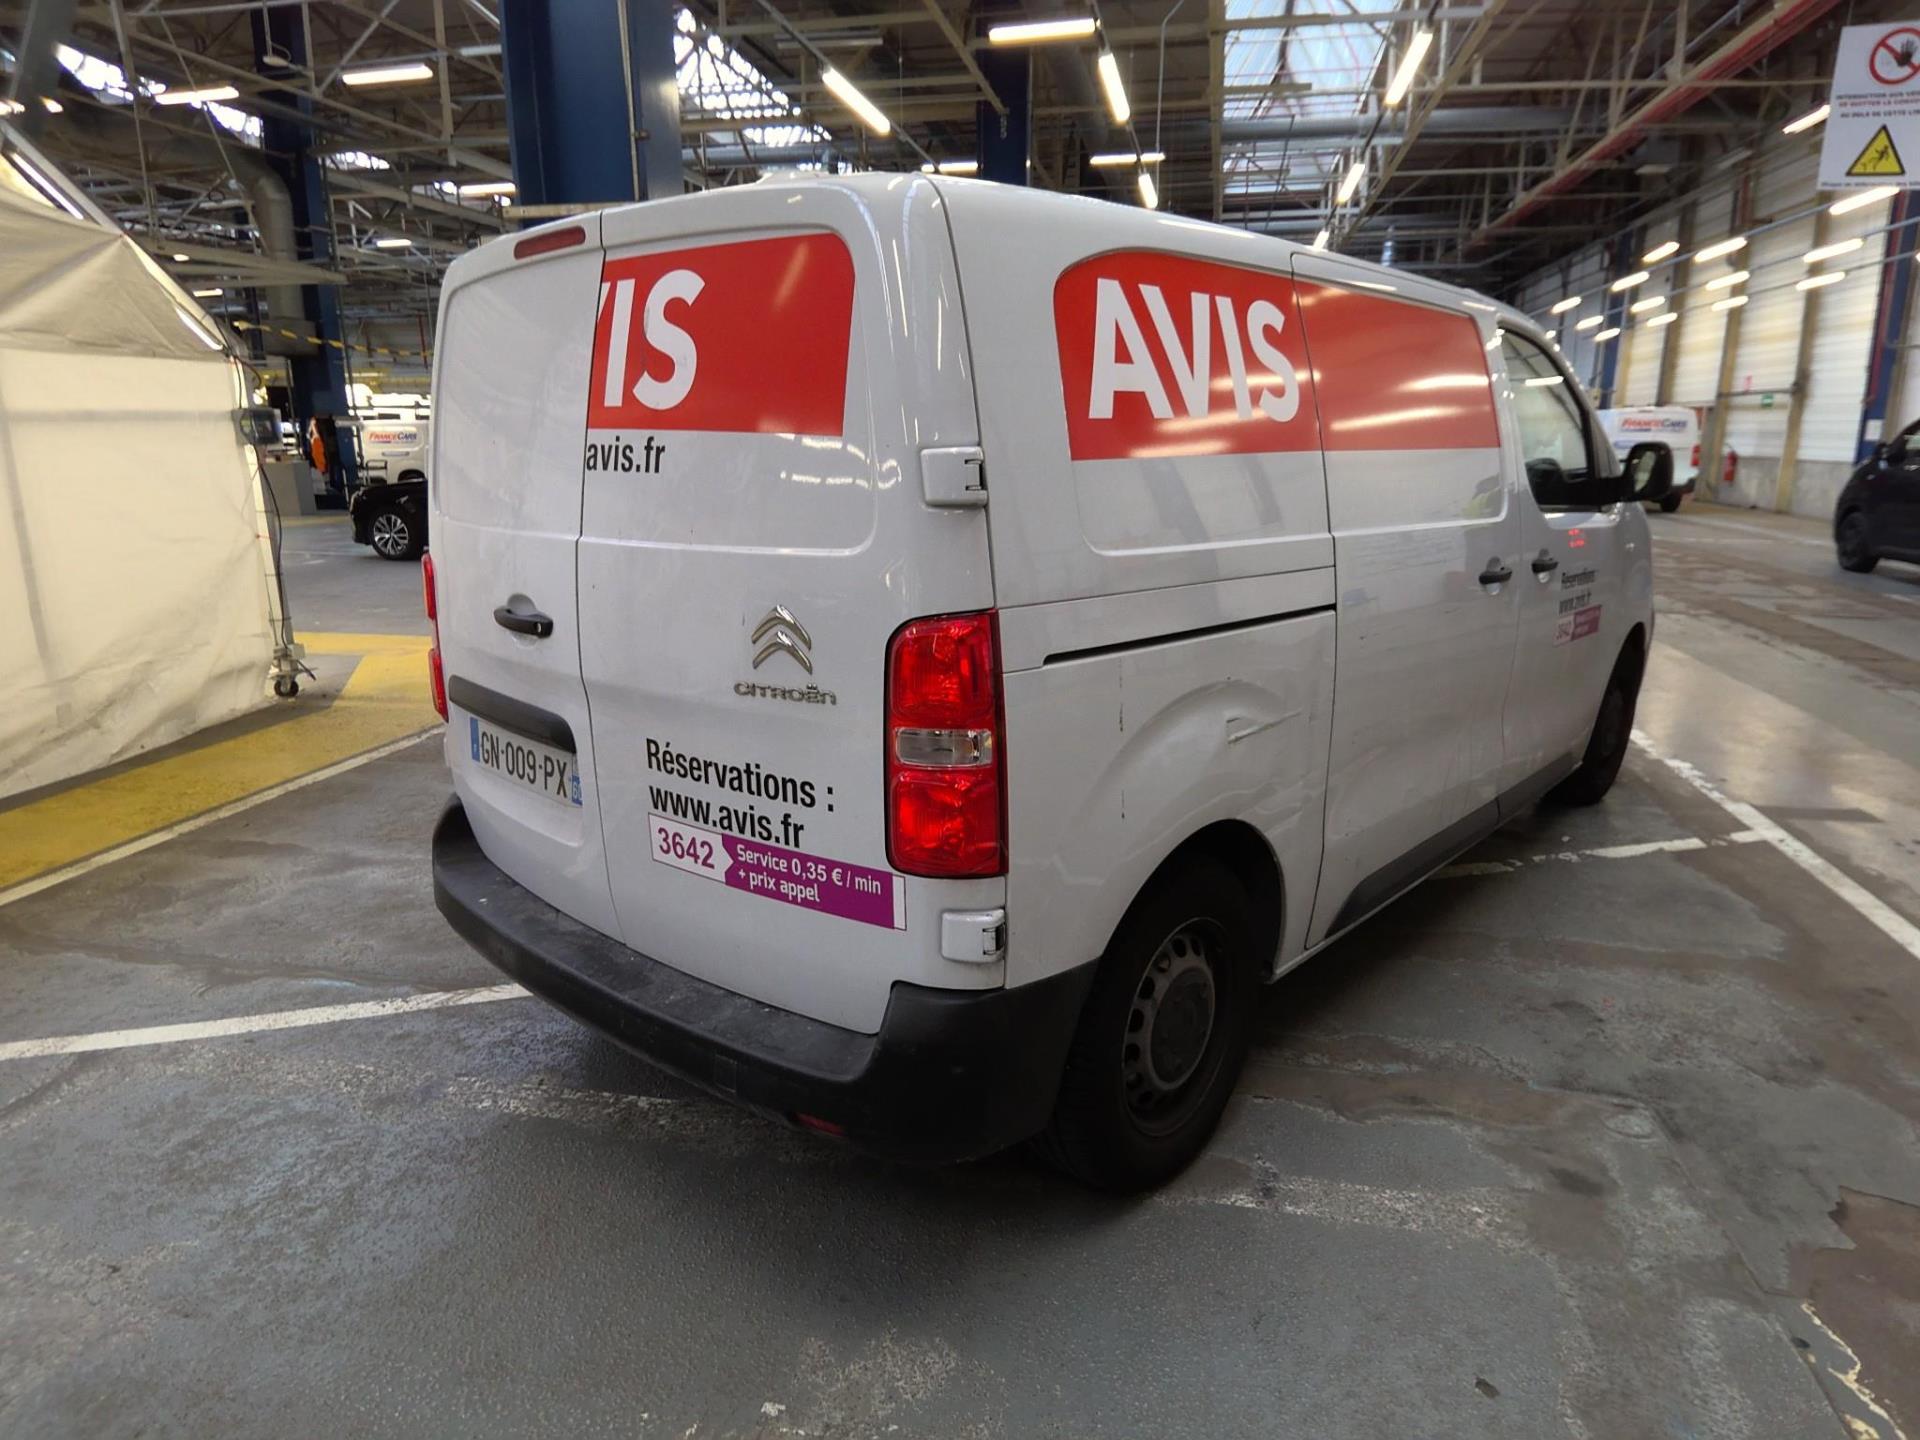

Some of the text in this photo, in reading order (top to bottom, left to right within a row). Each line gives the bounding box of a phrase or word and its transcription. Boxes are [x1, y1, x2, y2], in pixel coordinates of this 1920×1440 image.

[1088, 278, 1299, 422] AVIS
[586, 436, 665, 474] avis.fr
[734, 682, 837, 706] CITROËN
[646, 737, 816, 808] Réservations
[649, 785, 804, 848] www.avis.fr
[657, 827, 715, 870] 3642
[736, 844, 788, 873] Service
[791, 857, 827, 882] 0,35
[855, 876, 882, 895] min
[749, 870, 776, 890] prix
[780, 883, 820, 903] appel
